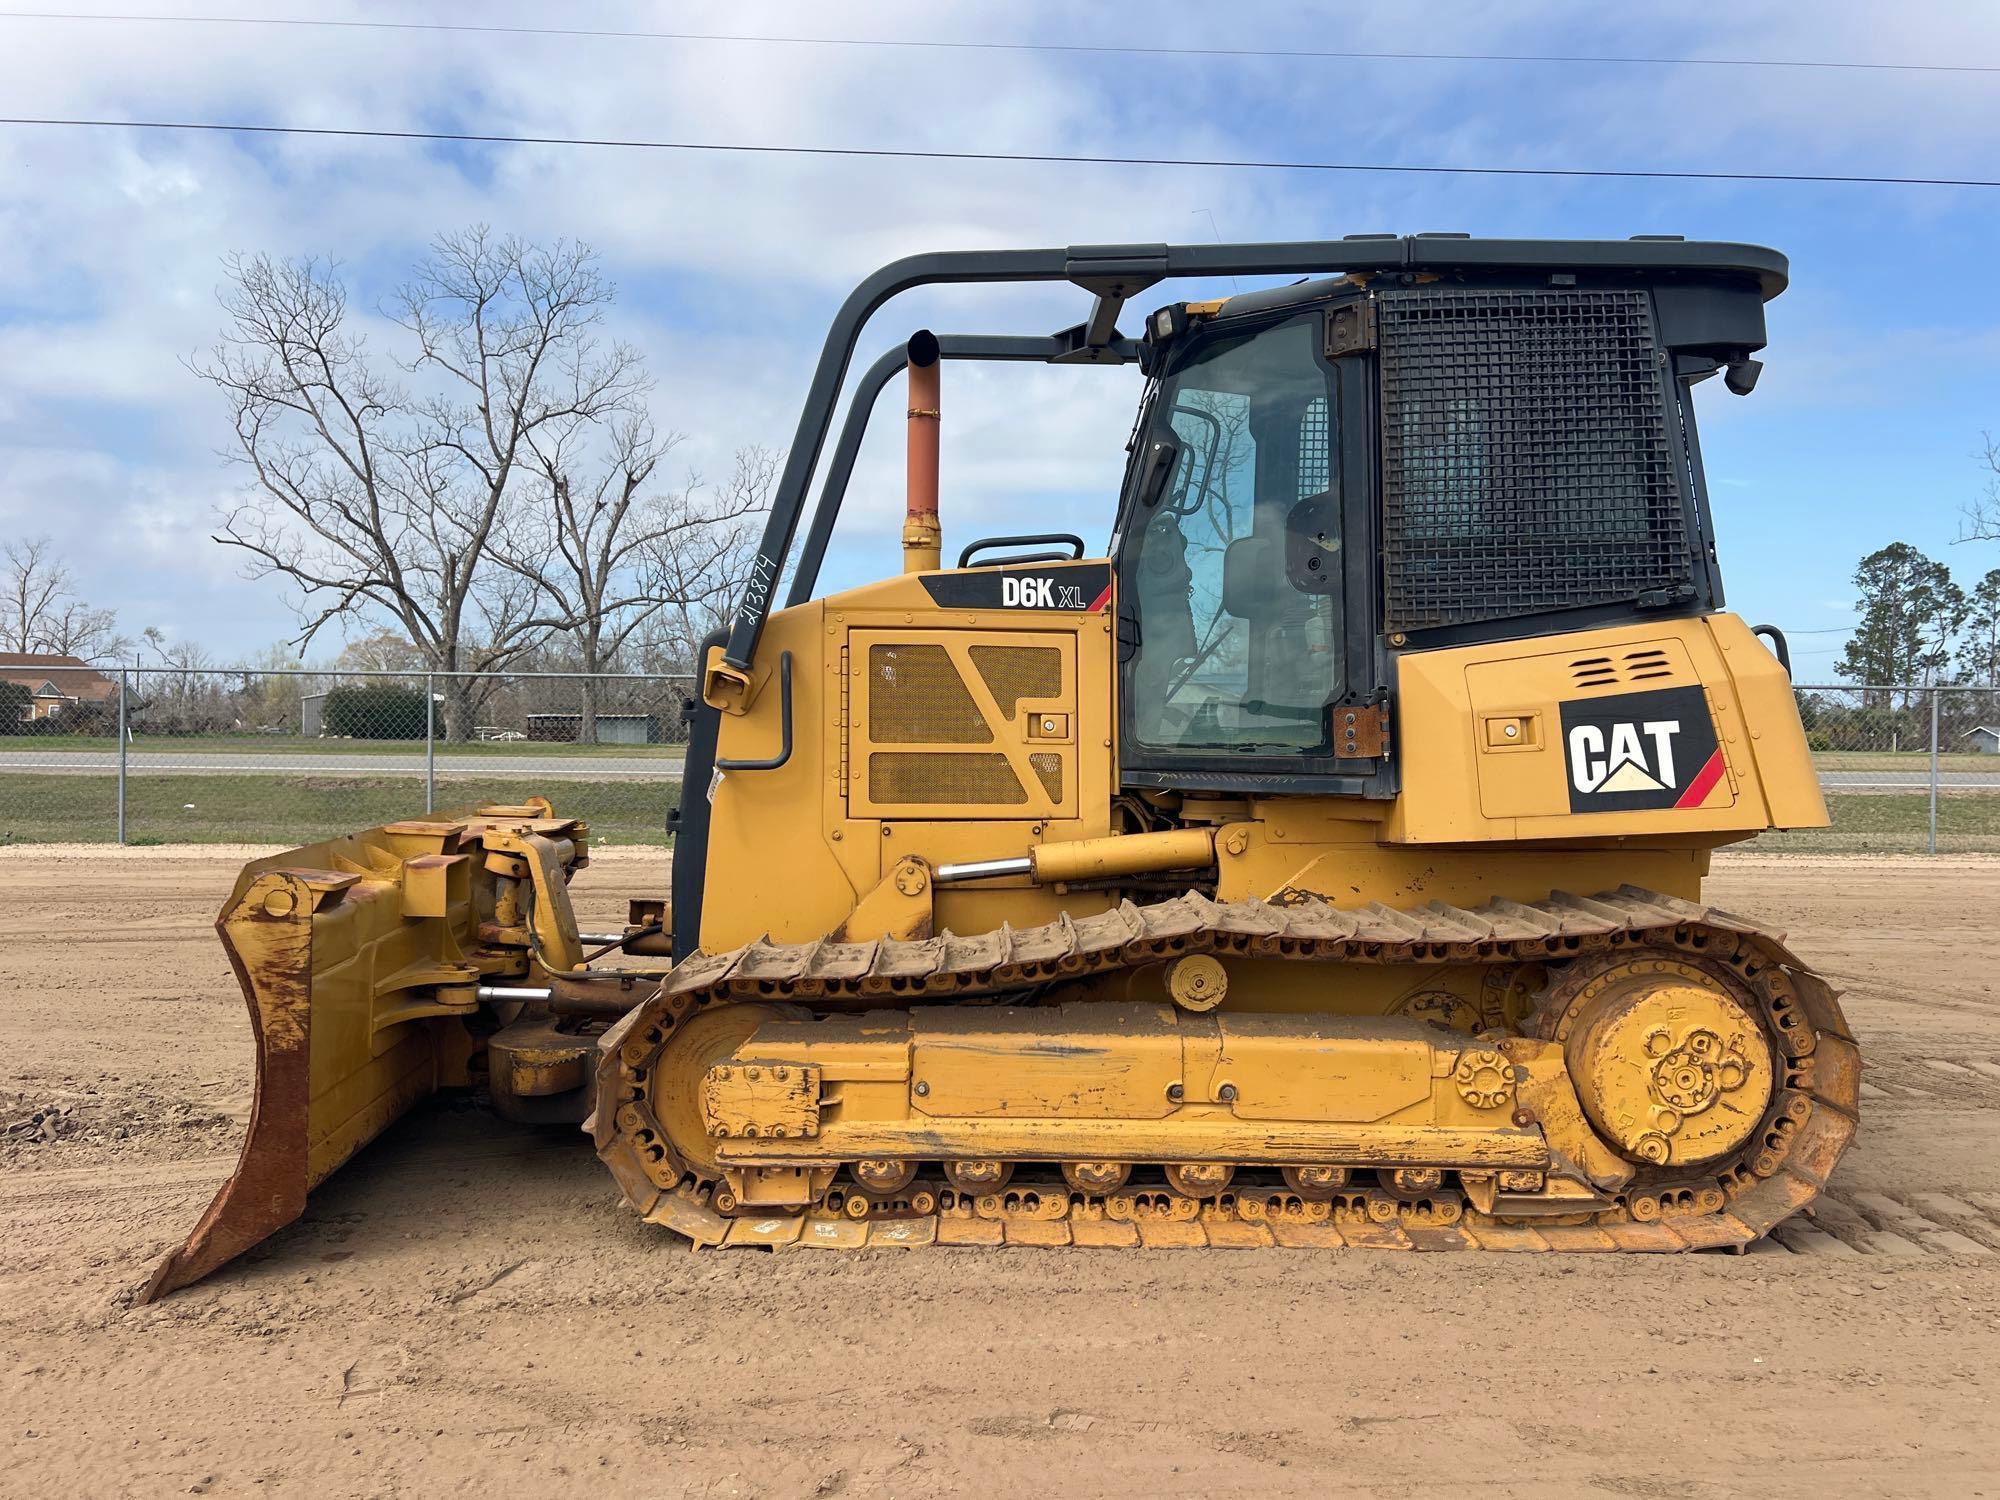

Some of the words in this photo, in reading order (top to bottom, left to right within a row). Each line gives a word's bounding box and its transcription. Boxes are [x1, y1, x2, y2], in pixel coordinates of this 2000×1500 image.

[739, 554, 777, 626] 213874
[1002, 577, 1055, 608] D6K
[1058, 586, 1086, 608] XL
[1569, 720, 1681, 794] CAT
